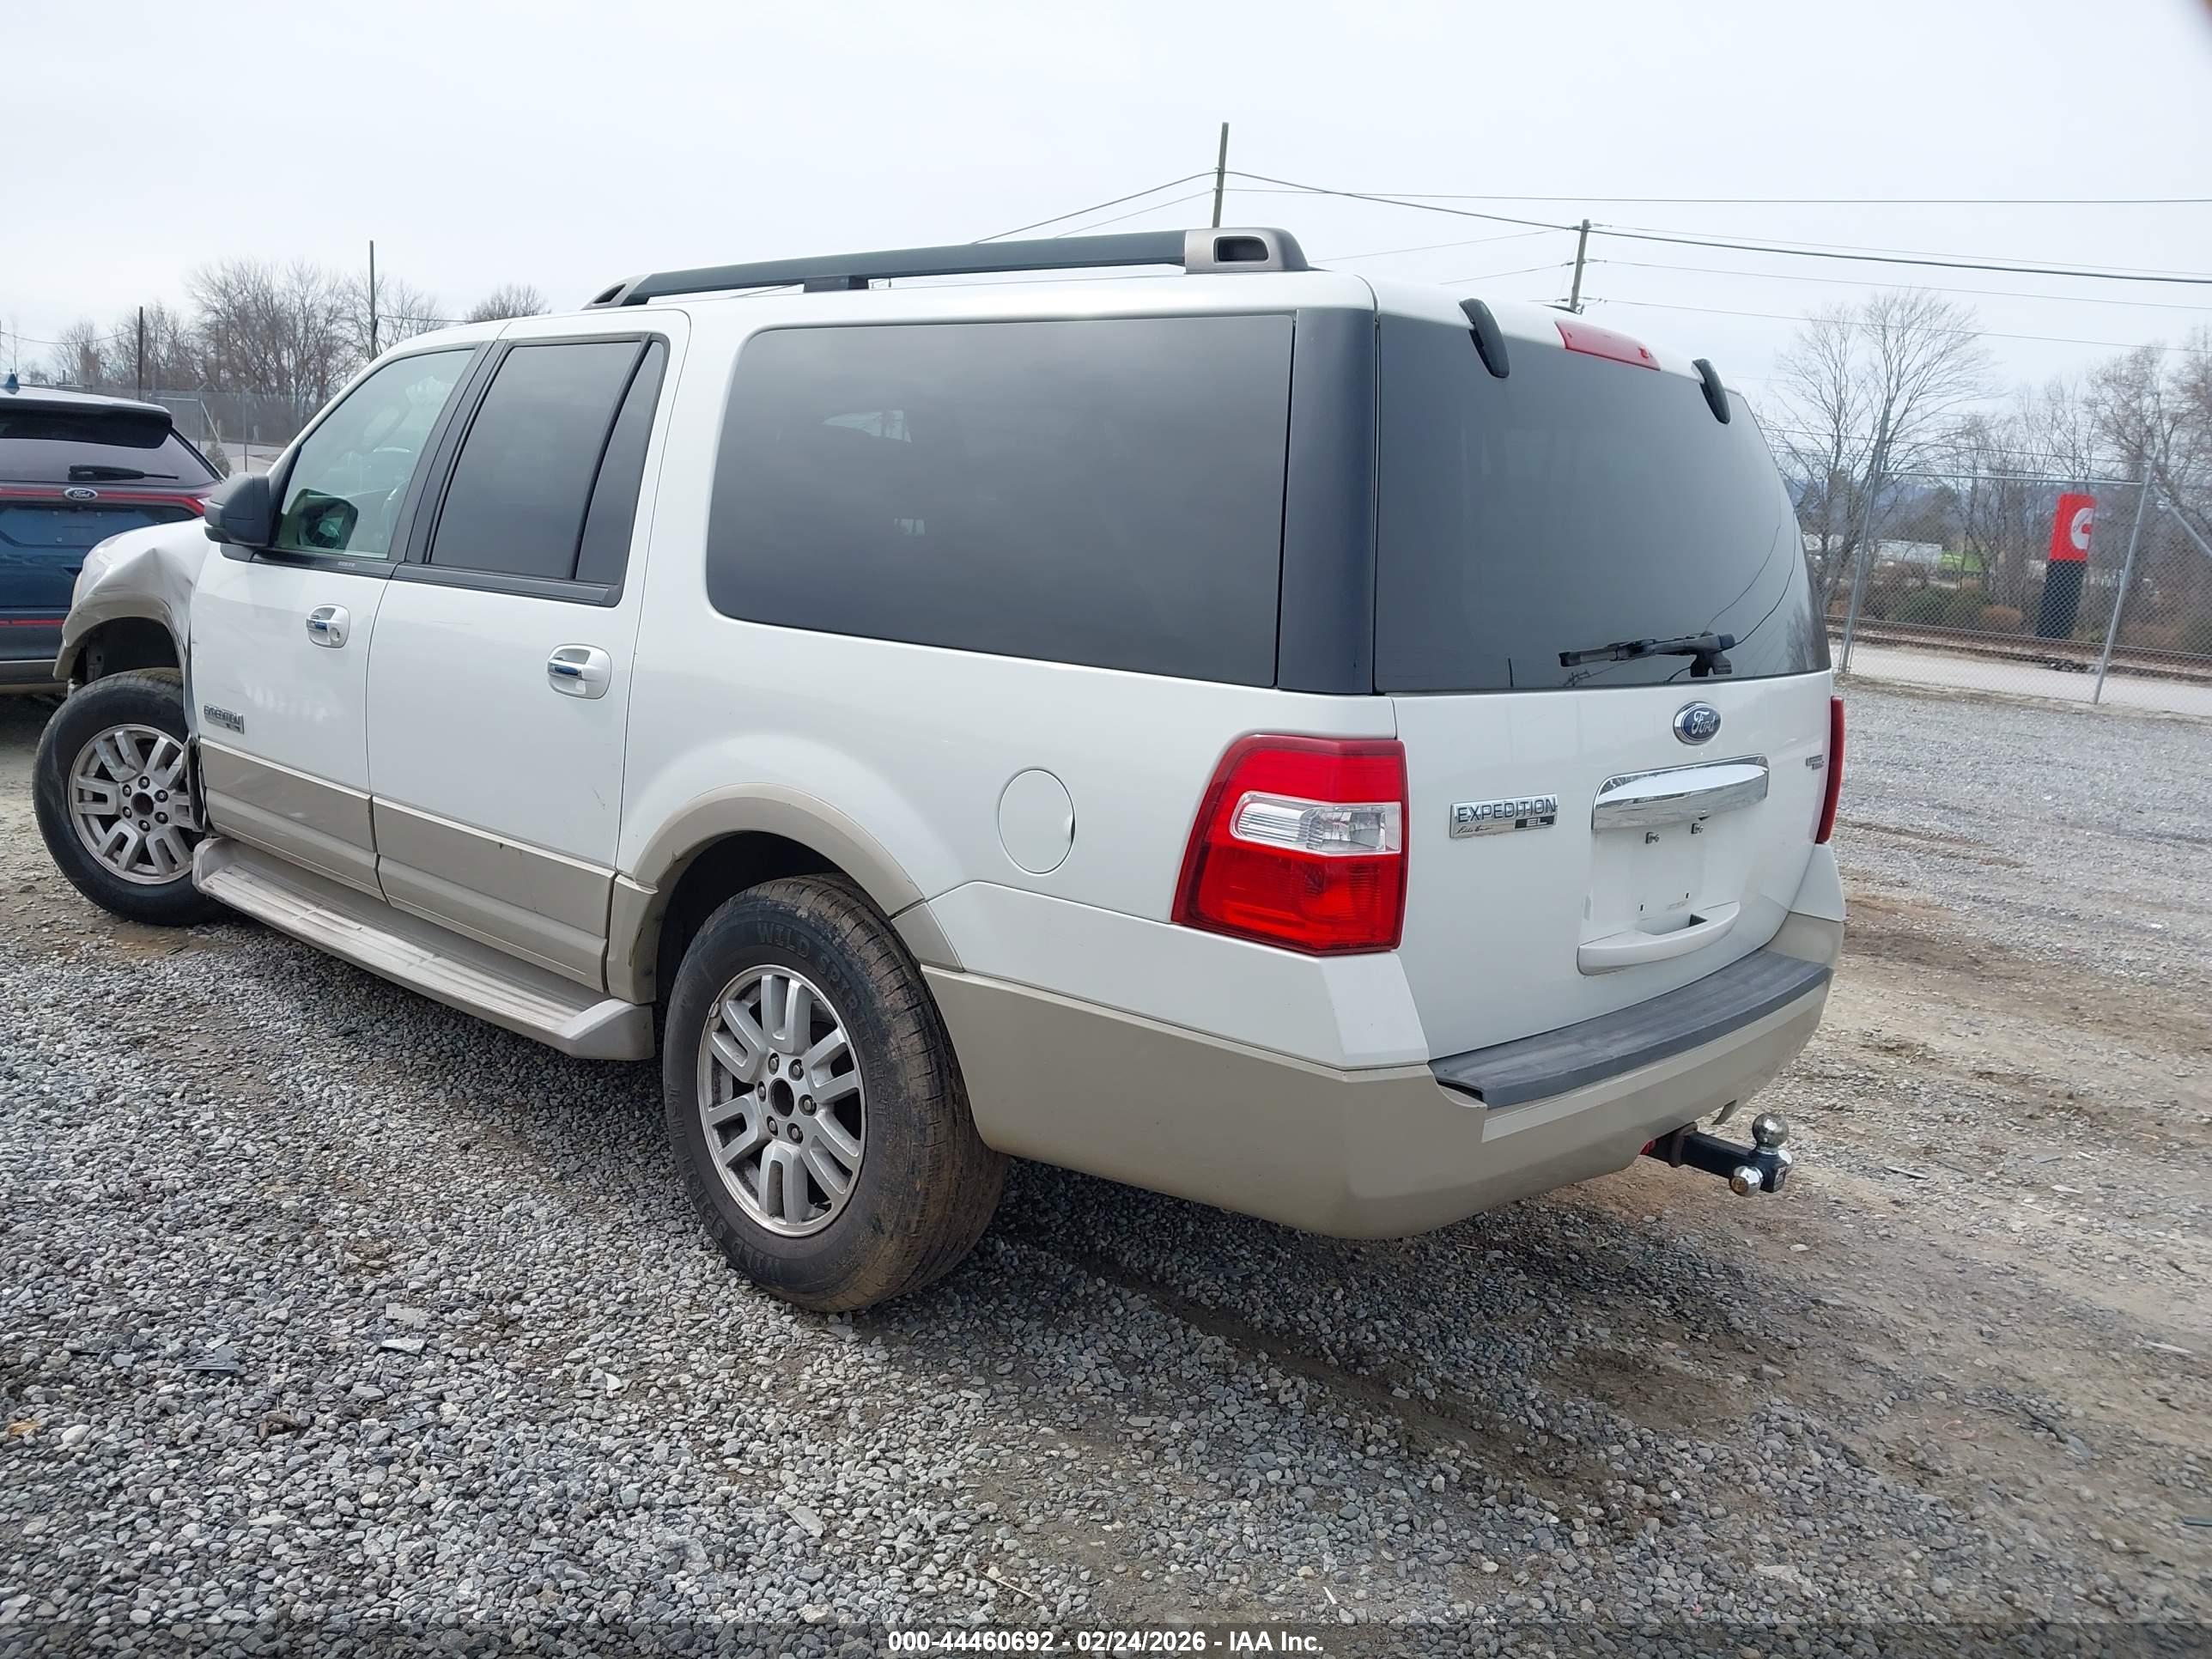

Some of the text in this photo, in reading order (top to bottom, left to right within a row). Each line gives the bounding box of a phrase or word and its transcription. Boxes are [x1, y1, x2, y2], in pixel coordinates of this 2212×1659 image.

[1691, 710, 1717, 735] Ford
[1457, 797, 1558, 823] EXPEDITION
[1527, 817, 1548, 826] EL
[757, 921, 811, 959] WILD
